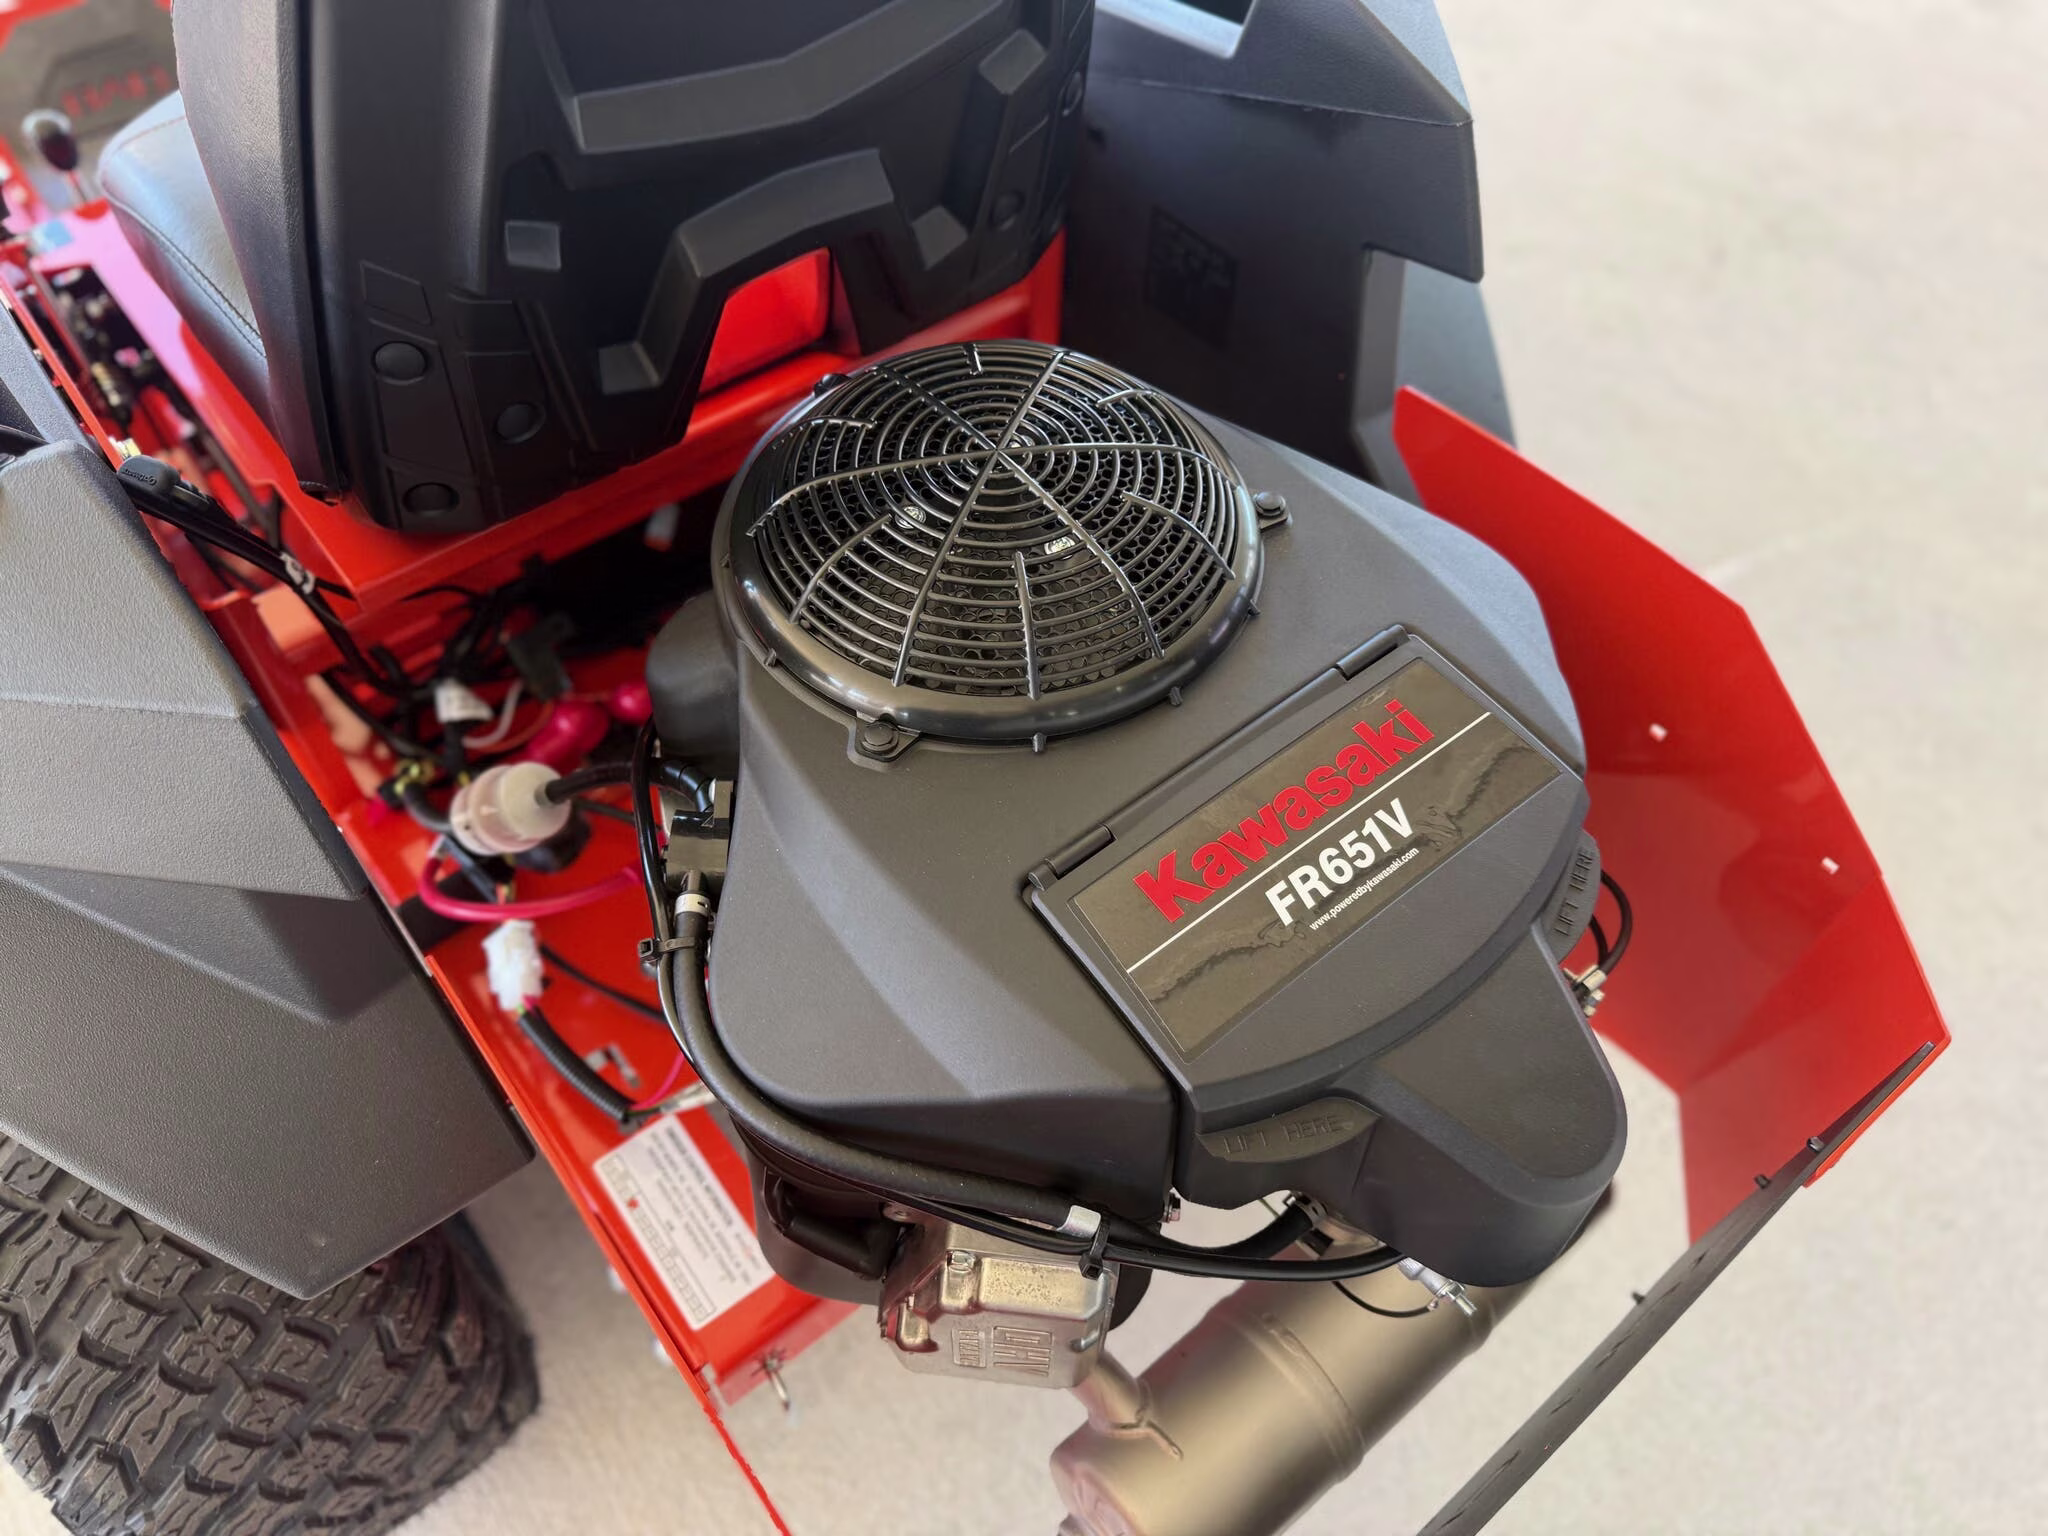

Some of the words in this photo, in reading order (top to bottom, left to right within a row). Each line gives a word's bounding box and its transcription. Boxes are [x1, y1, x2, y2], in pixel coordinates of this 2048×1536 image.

[1133, 699, 1434, 923] Kawasaki
[1265, 797, 1414, 927] FR651V
[1309, 847, 1420, 931] www.poweredbykawasaki.com
[1222, 1127, 1269, 1156] LIFT
[1279, 1113, 1344, 1144] HERE
